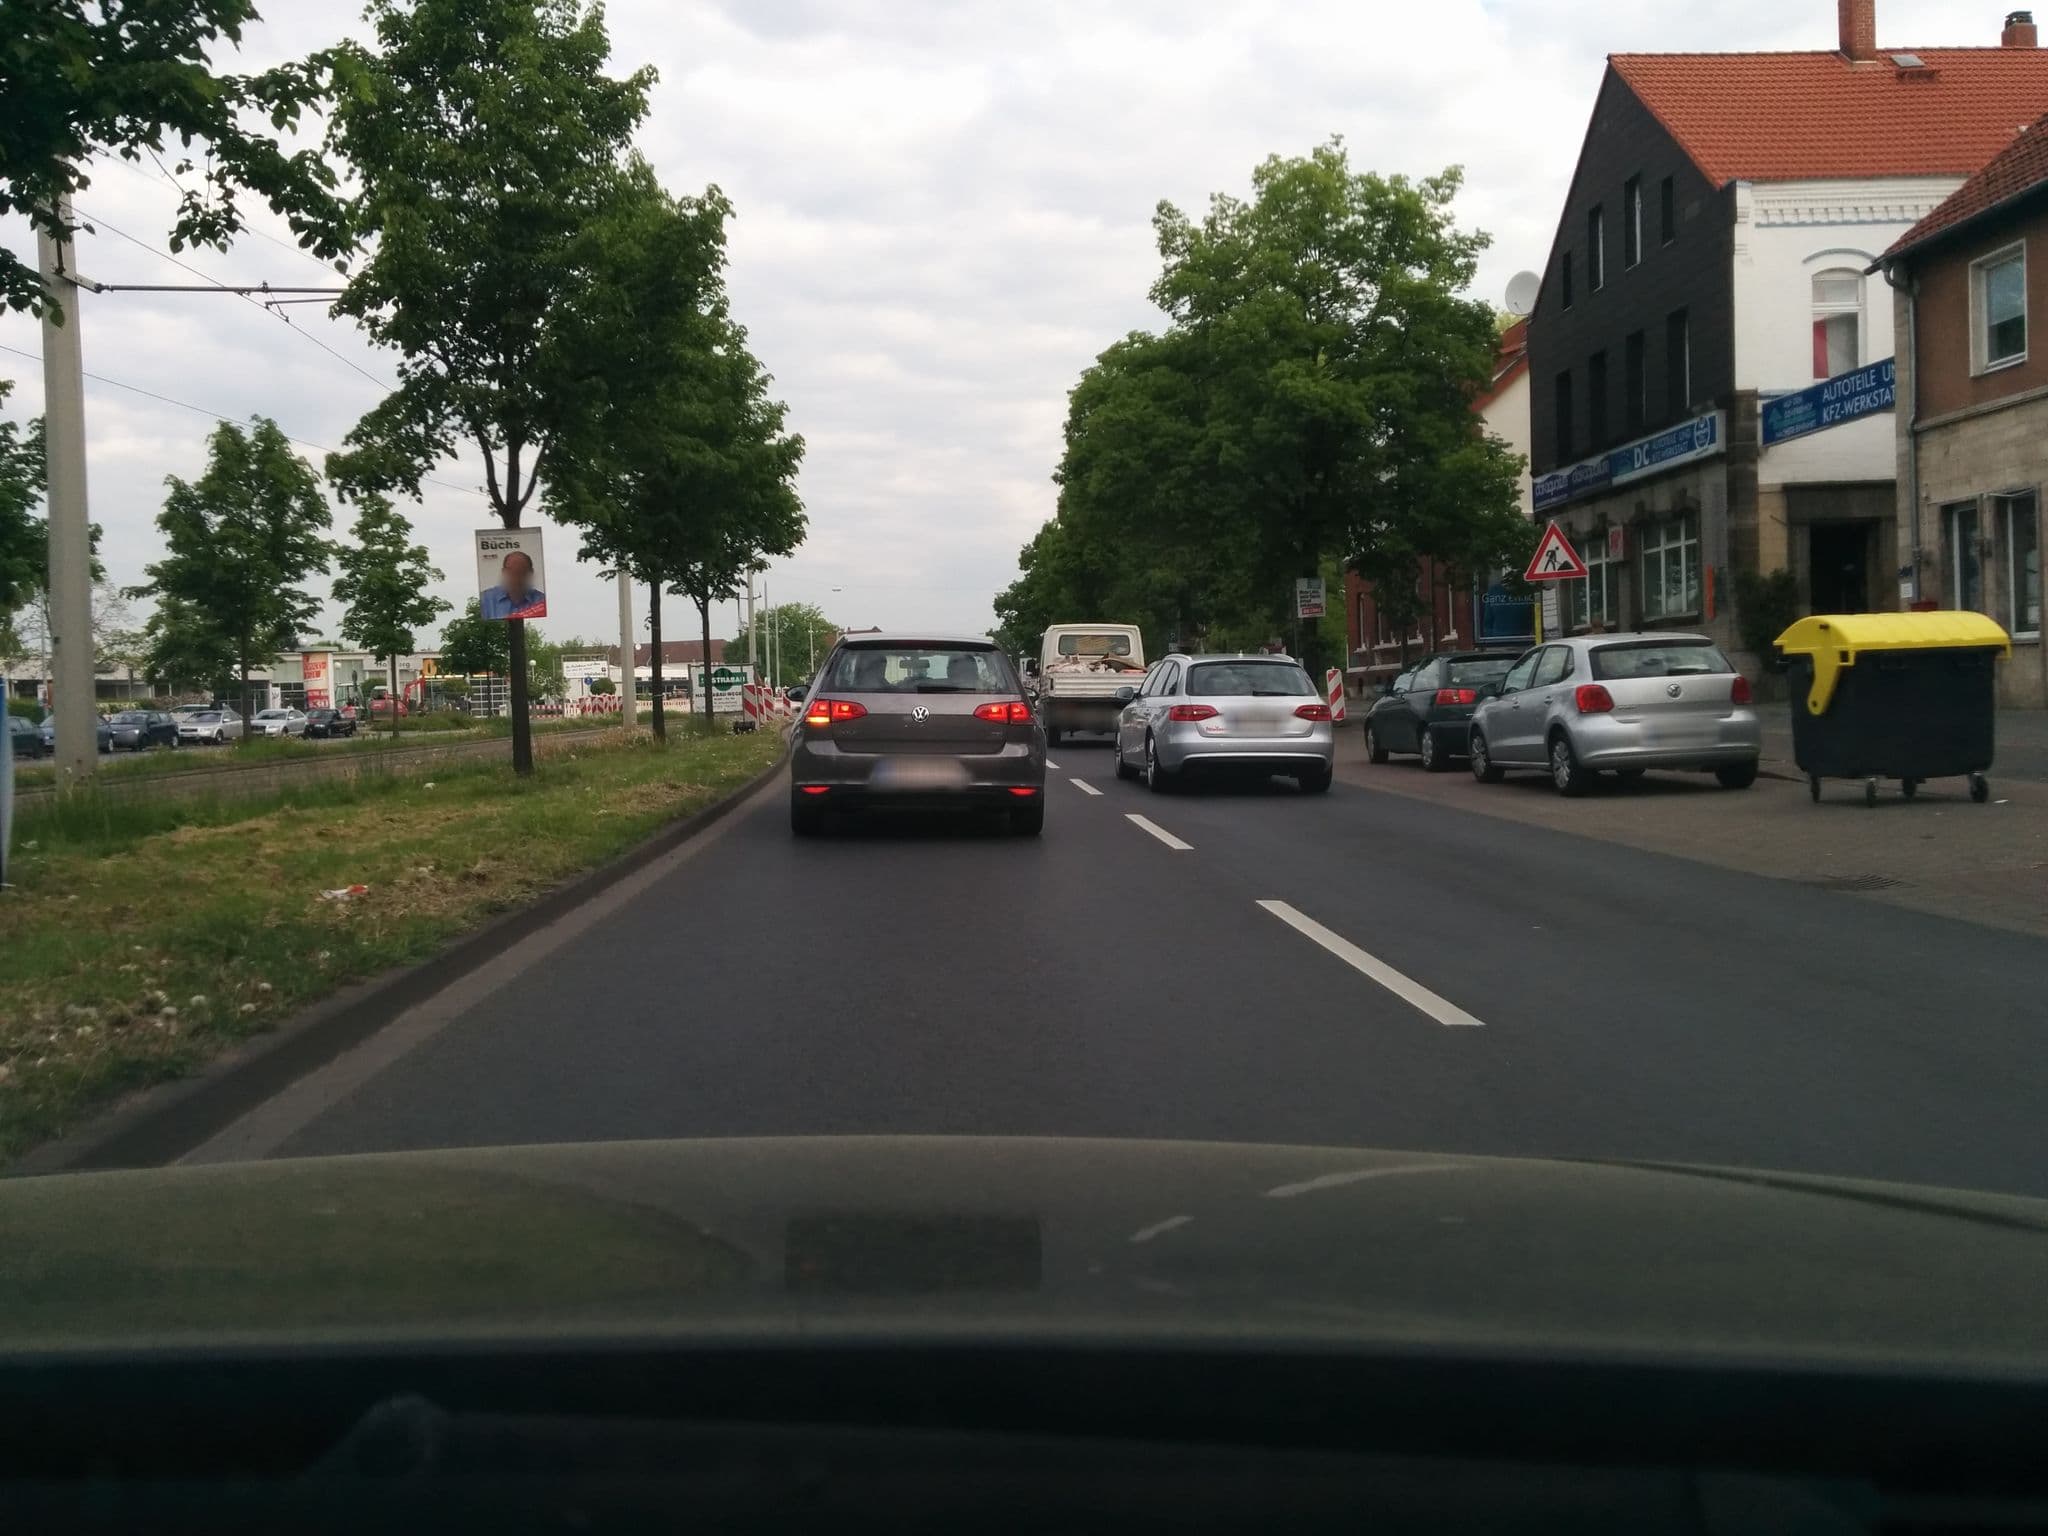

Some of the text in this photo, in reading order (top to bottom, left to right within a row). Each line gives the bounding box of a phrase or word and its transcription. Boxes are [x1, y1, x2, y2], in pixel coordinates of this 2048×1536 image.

[1823, 369, 1876, 402] AUTOTEILE
[1634, 443, 1650, 469] DC
[480, 540, 521, 550] Büchs
[1482, 593, 1506, 603] Ganz
